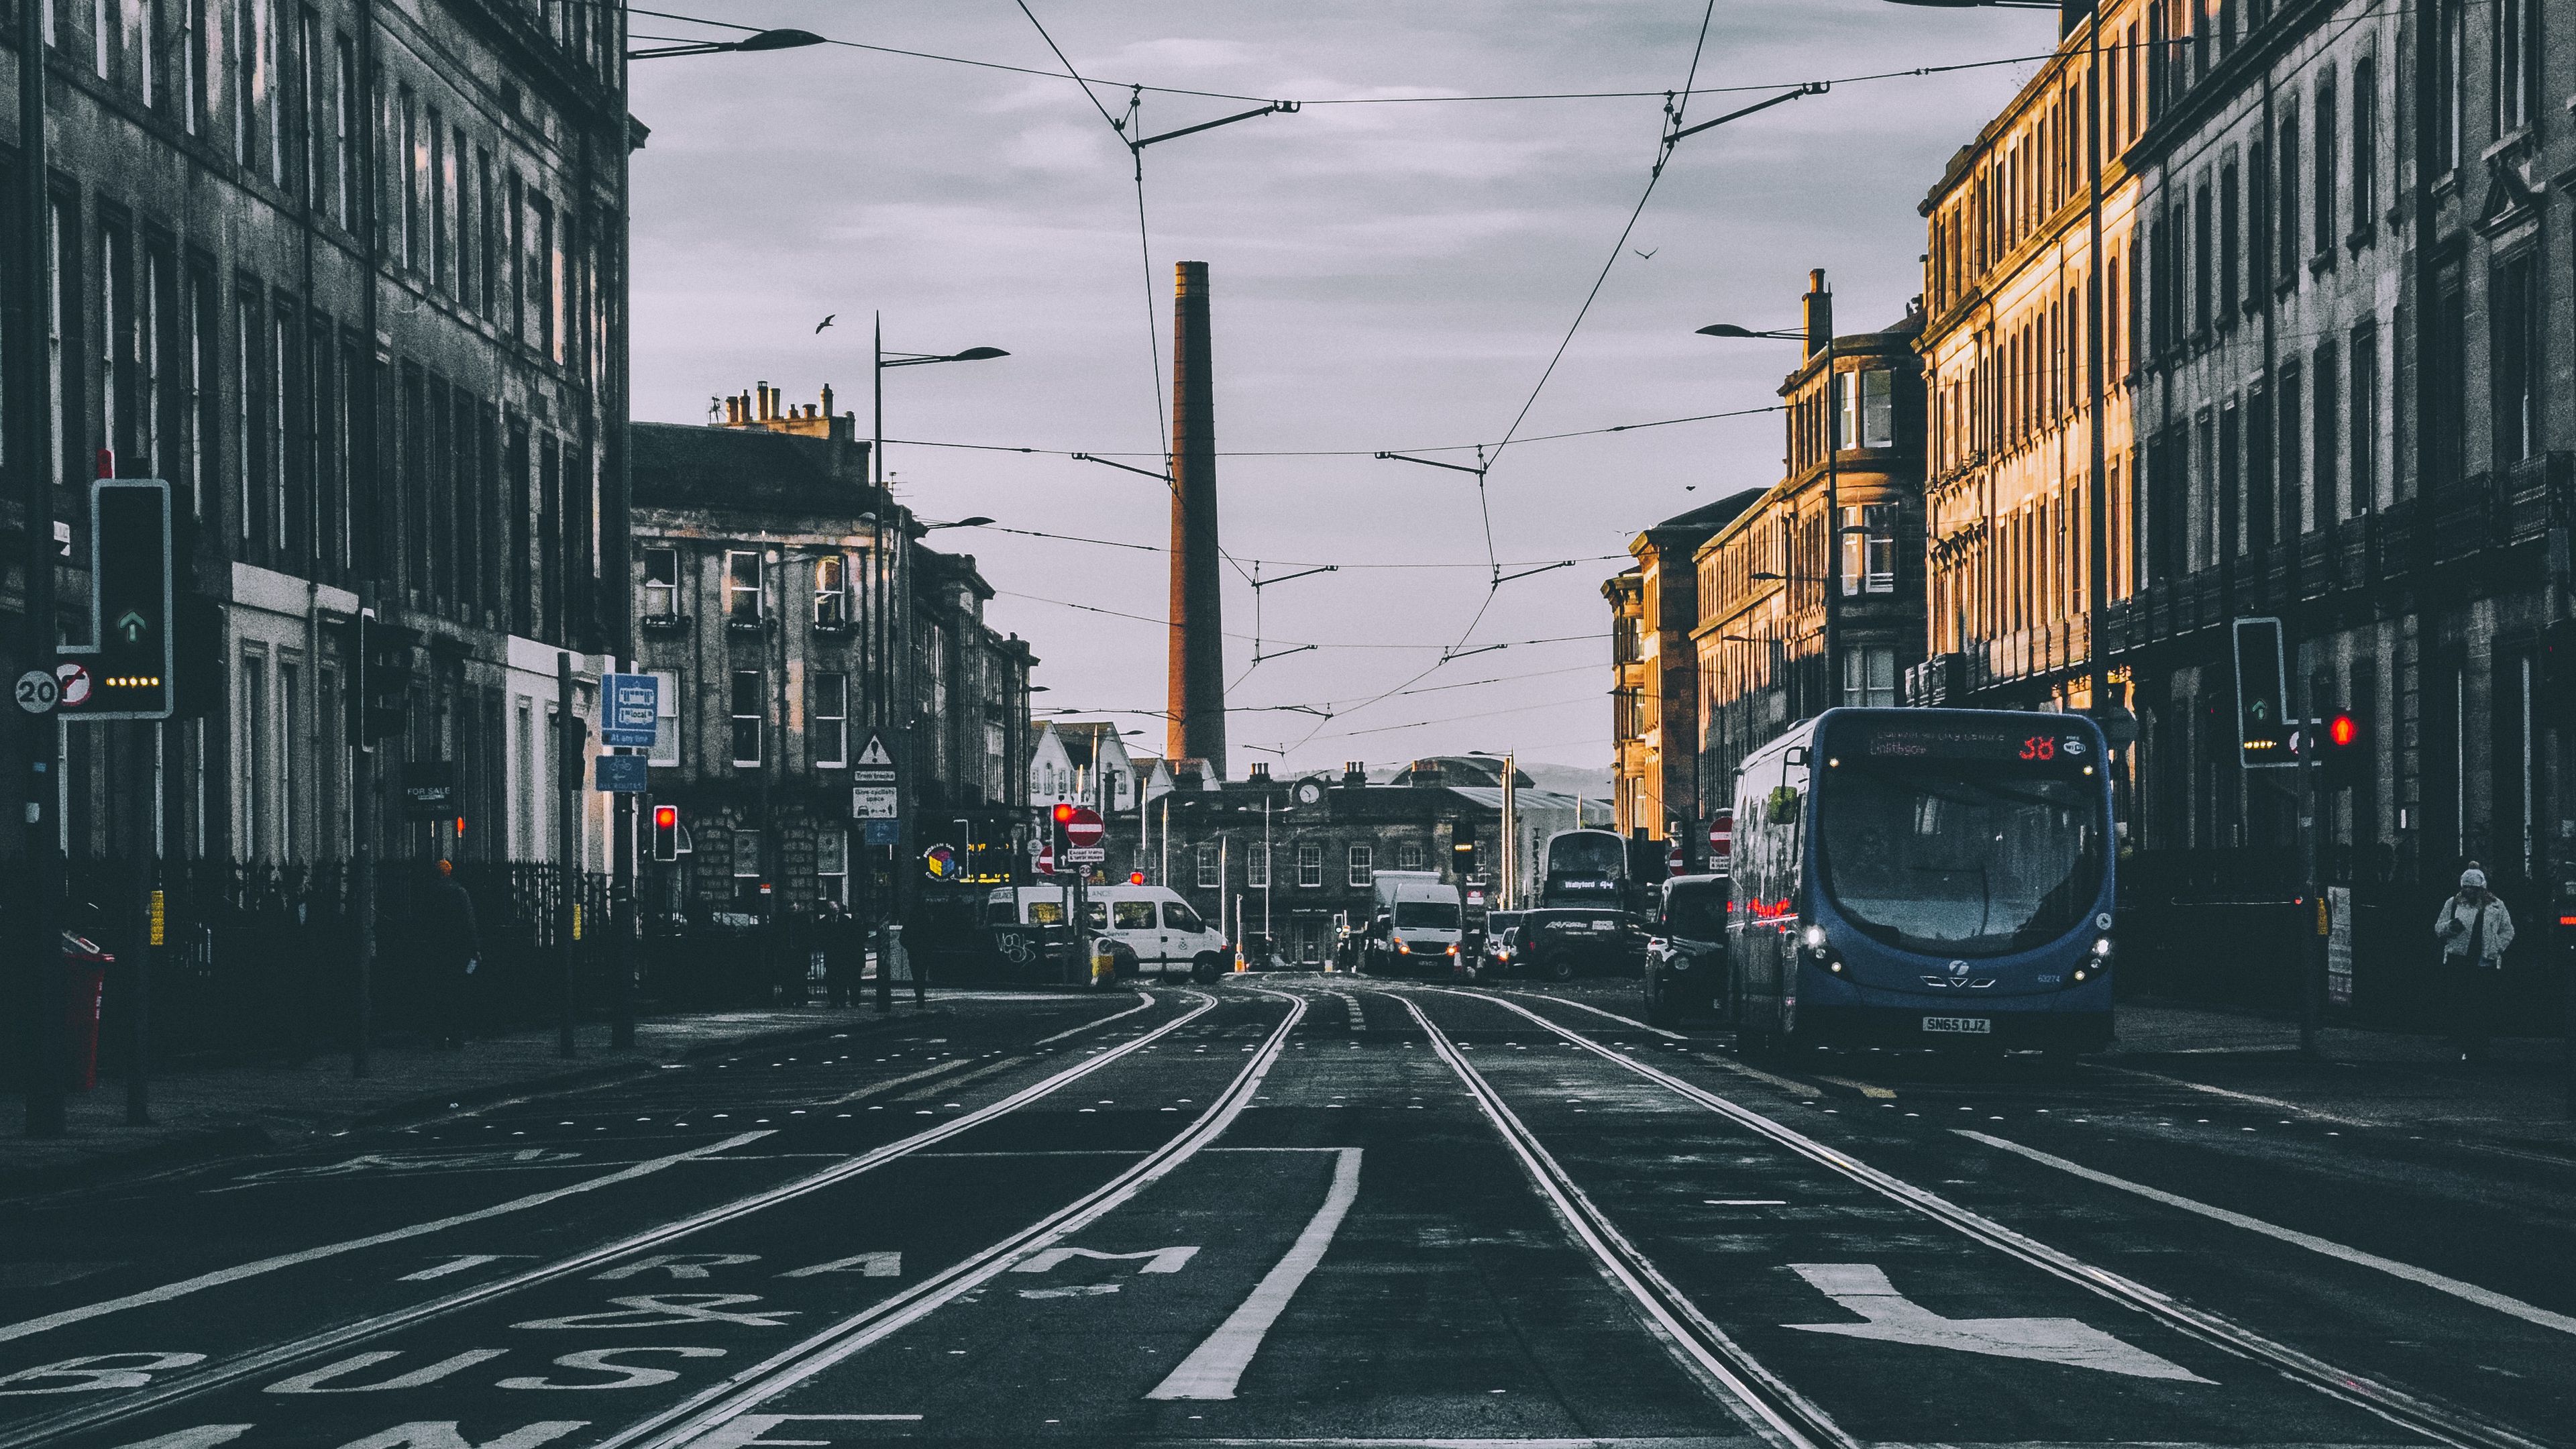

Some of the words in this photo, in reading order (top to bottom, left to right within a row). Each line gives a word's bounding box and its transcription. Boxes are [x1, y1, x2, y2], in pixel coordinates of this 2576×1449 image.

[19, 681, 55, 702] 20
[631, 708, 647, 718] local
[610, 733, 620, 742] At
[2019, 736, 2055, 761] 38
[407, 788, 425, 796] FOR
[428, 786, 451, 796] SALE
[2037, 975, 2061, 983] 63274
[1927, 1018, 1959, 1030] SN65
[1962, 1020, 1986, 1032] OJZ
